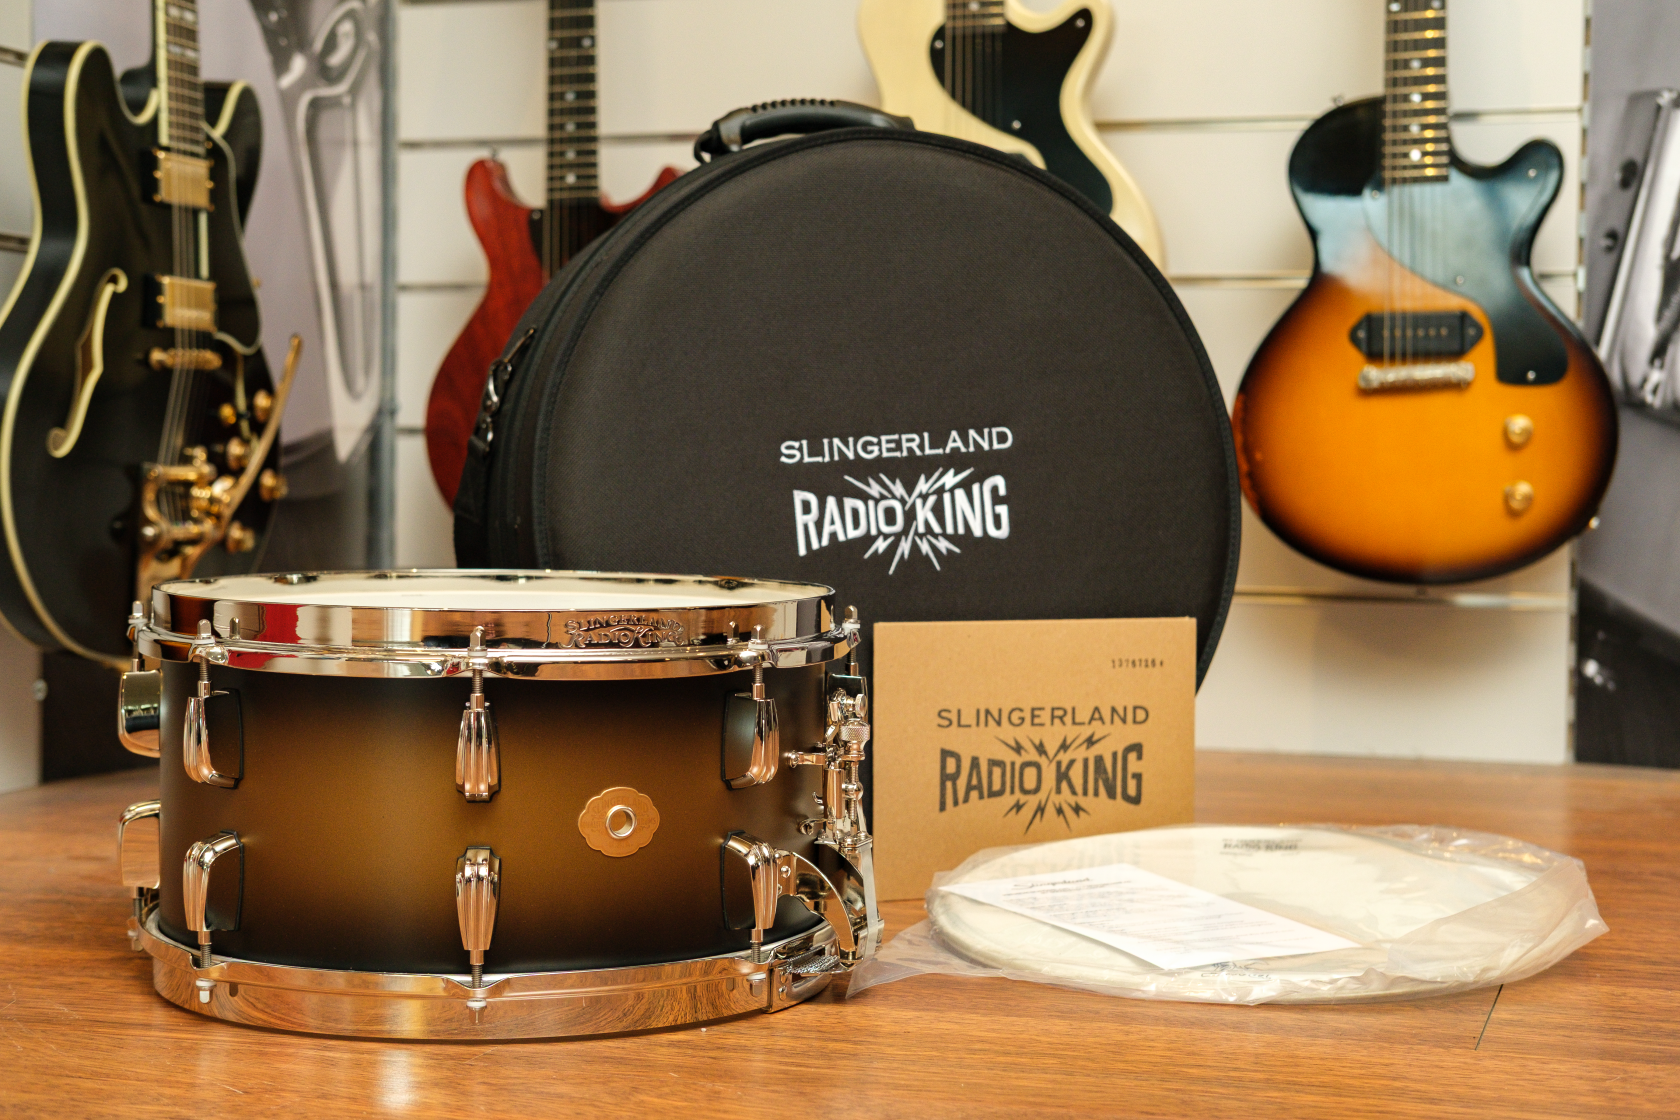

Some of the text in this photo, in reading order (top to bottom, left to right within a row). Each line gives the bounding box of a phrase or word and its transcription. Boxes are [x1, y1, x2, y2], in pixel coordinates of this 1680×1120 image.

[780, 426, 1013, 464] SLINGERLAND
[793, 474, 1011, 556] RADIO KING
[558, 625, 685, 648] RADIO KING
[565, 614, 685, 635] SLINGERLAND
[937, 705, 1149, 729] SLINGERLAND
[938, 741, 1144, 813] RADIO KING
